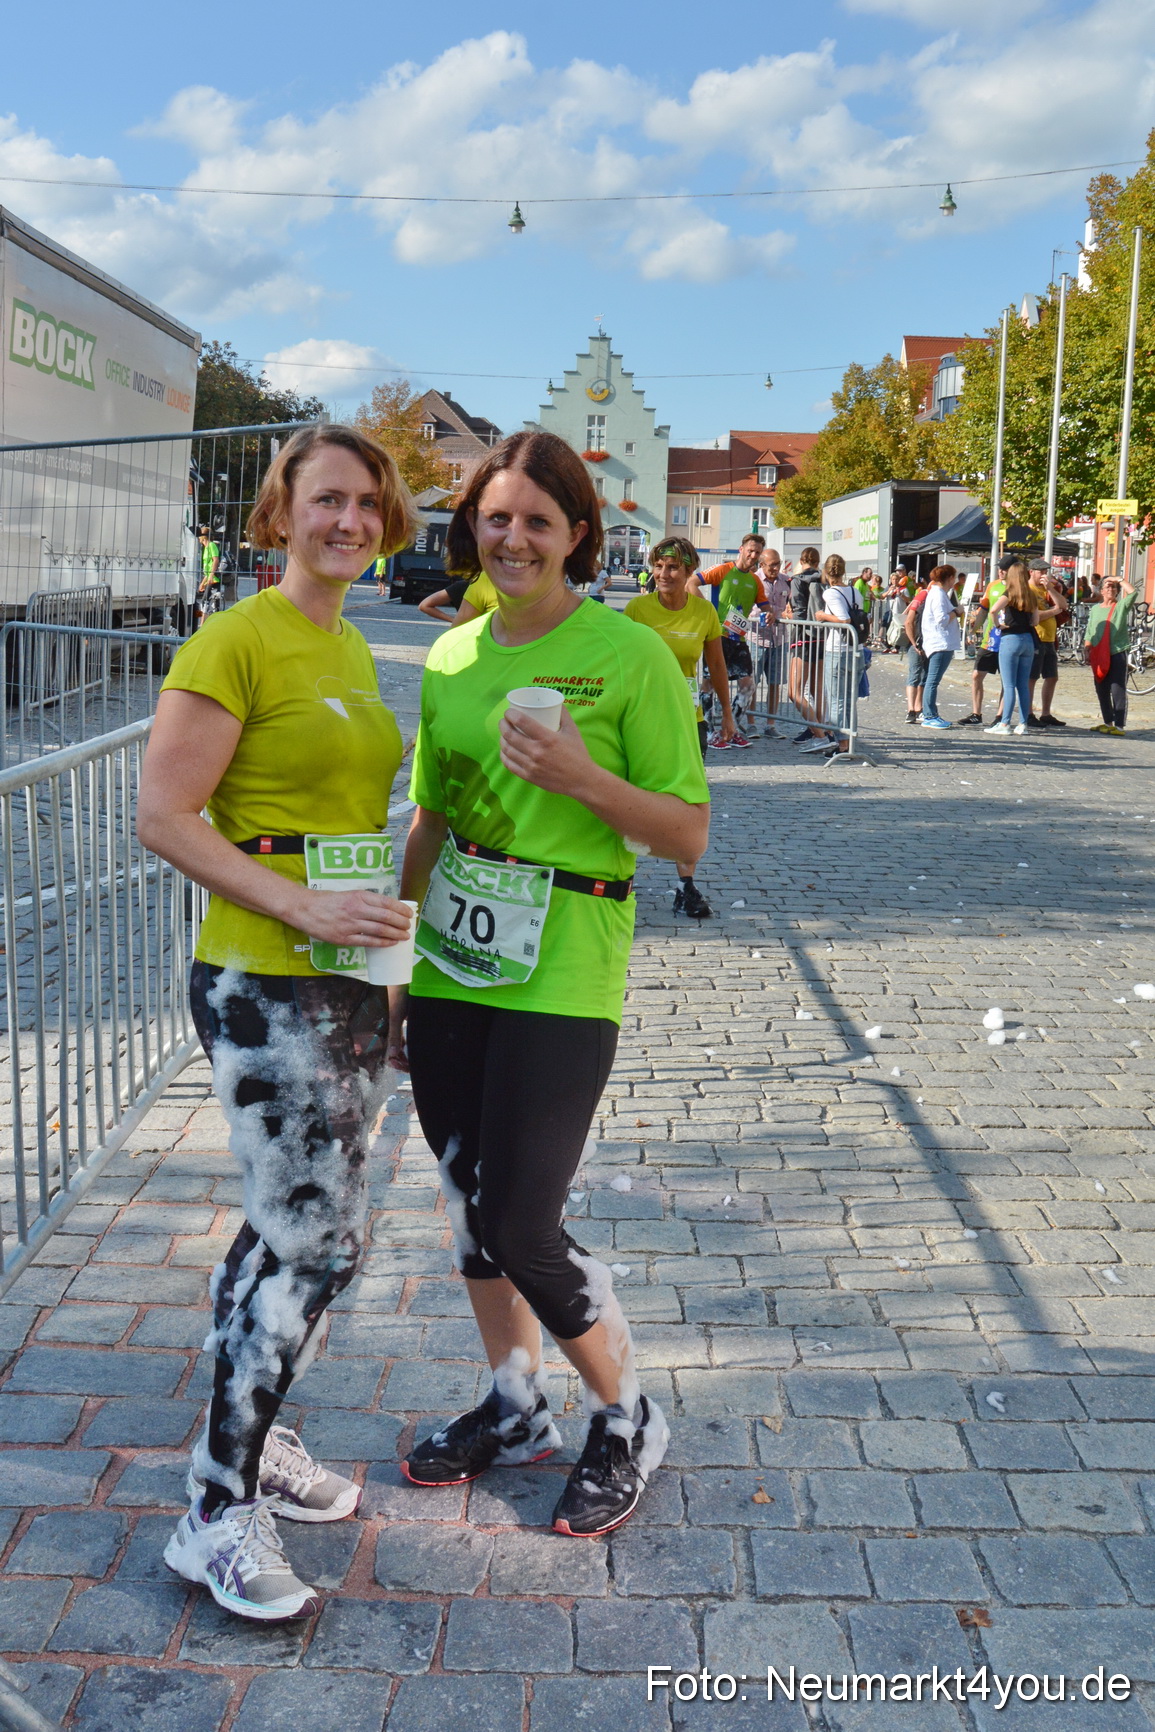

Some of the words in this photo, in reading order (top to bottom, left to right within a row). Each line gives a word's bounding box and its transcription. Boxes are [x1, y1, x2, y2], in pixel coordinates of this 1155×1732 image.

[11, 303, 95, 387] BOCK
[105, 358, 130, 388] OFFICE
[133, 370, 165, 402] INDUSTRY
[166, 387, 191, 414] LOUNGE
[35, 452, 43, 470] by
[731, 614, 747, 629] 530
[532, 675, 605, 687] NEUMARKTER
[577, 699, 596, 707] 2019
[449, 892, 496, 944] 70
[530, 918, 540, 927] E6
